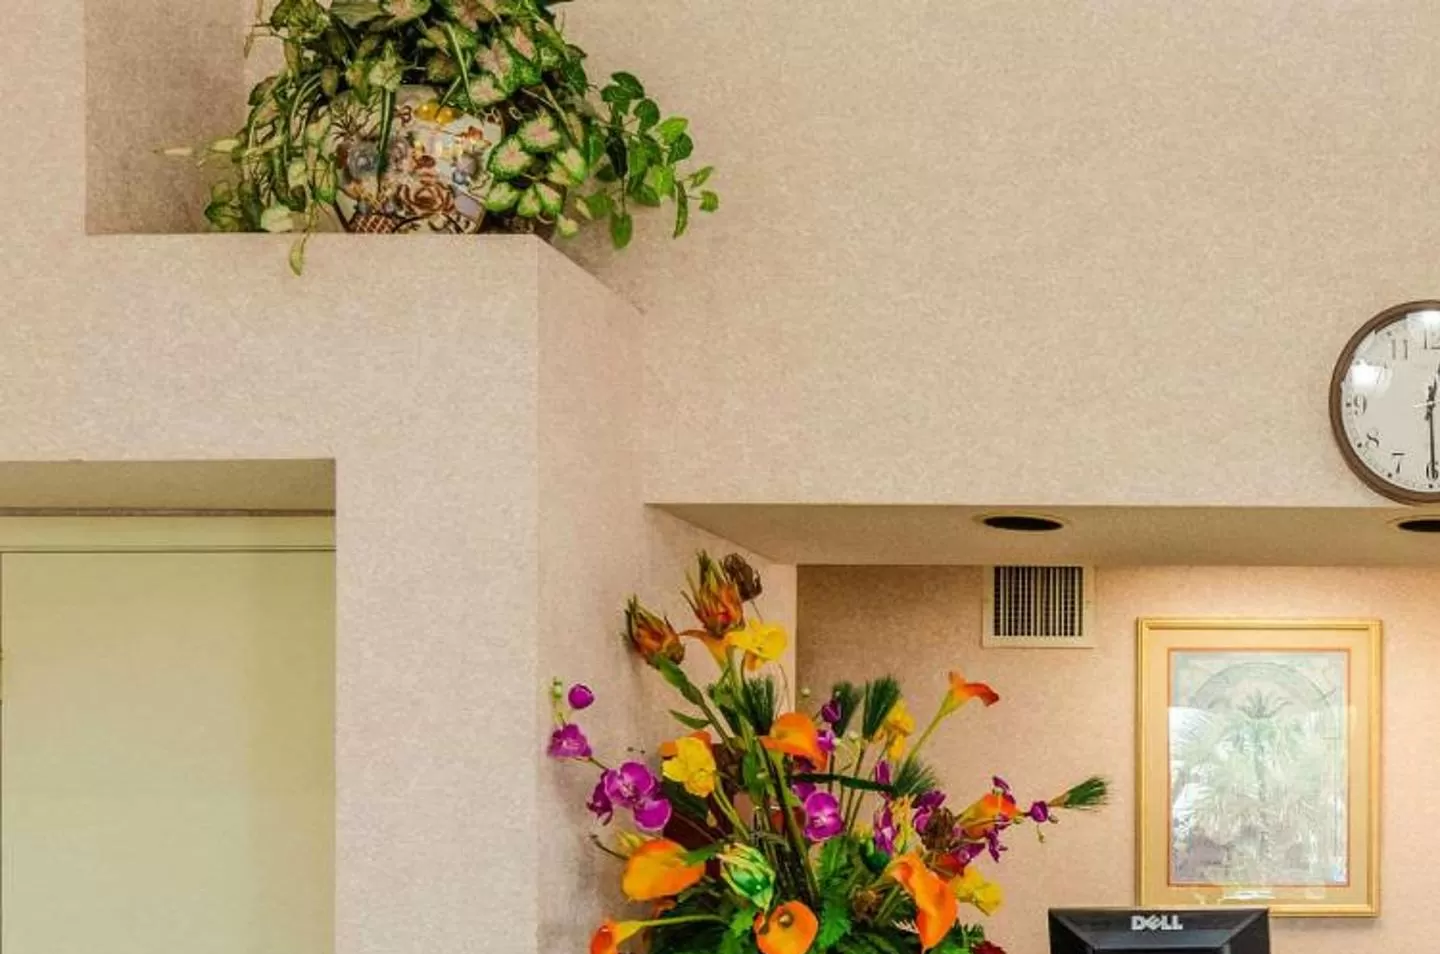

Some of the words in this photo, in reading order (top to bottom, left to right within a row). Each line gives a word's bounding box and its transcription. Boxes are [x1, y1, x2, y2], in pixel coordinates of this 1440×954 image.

[1391, 339, 1408, 360] 11
[1353, 394, 1368, 416] 9
[1366, 428, 1381, 450] 8
[1391, 452, 1406, 474] 7
[1425, 461, 1439, 481] 6
[1130, 915, 1183, 930] DELL
